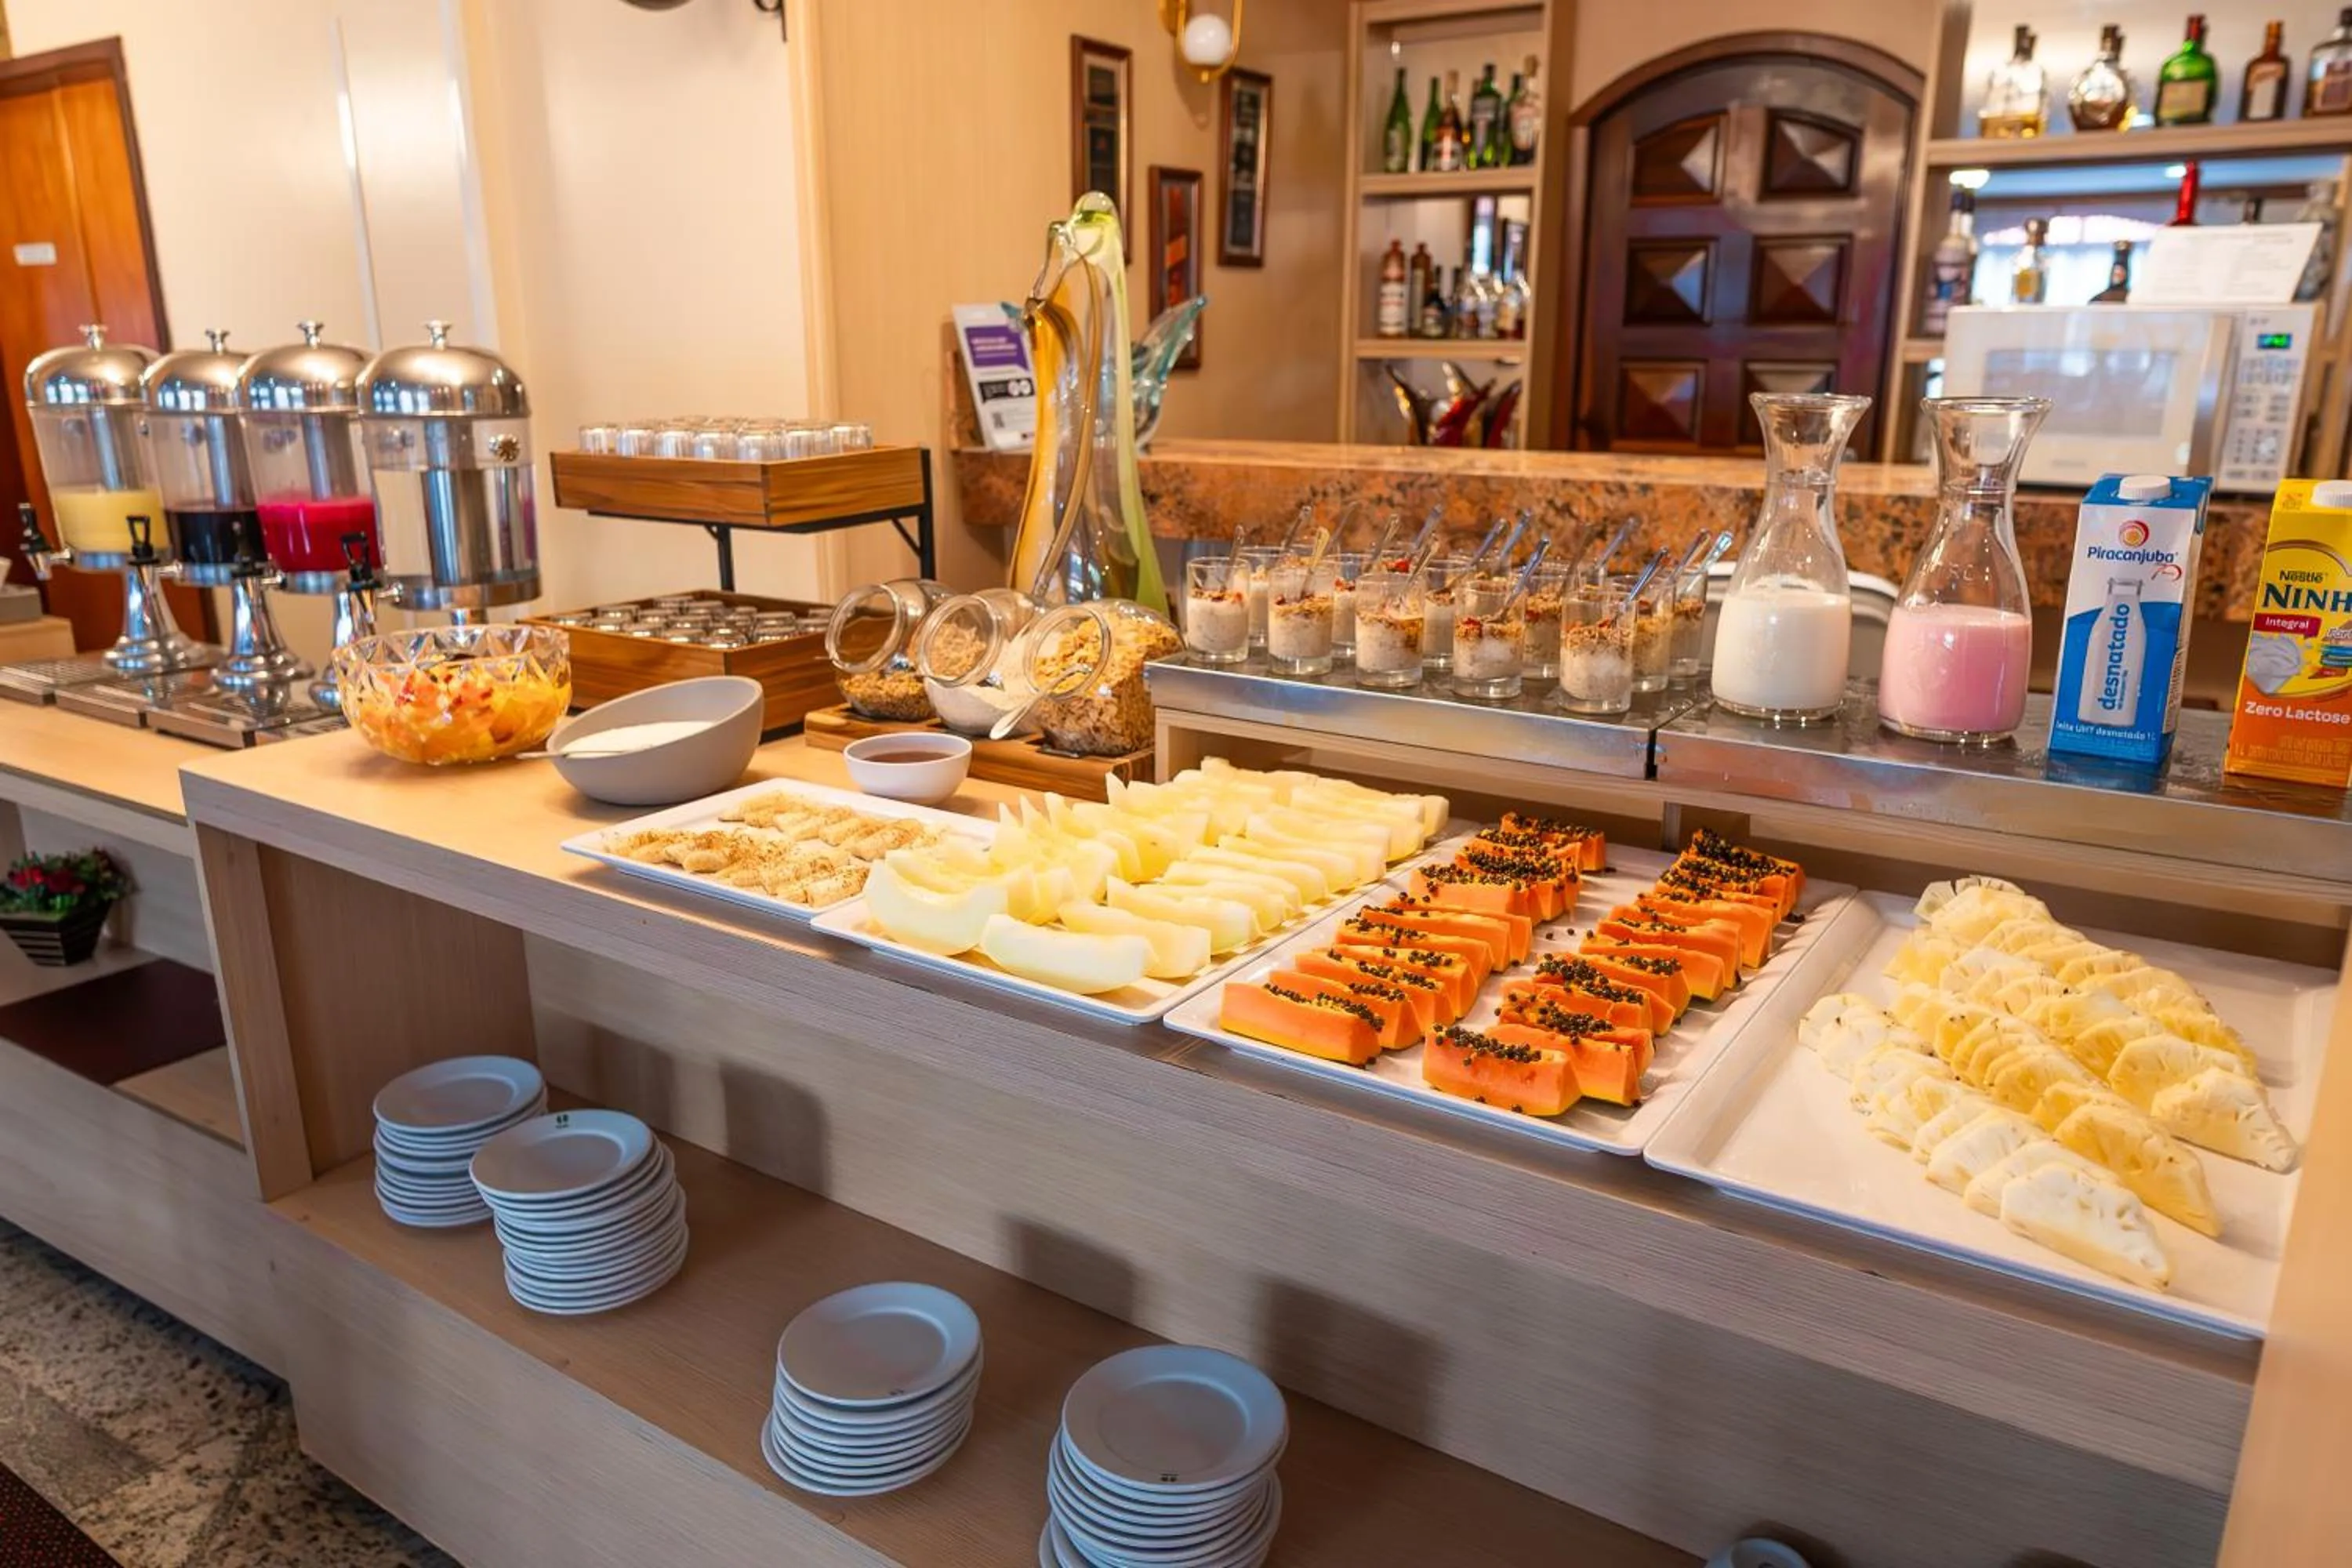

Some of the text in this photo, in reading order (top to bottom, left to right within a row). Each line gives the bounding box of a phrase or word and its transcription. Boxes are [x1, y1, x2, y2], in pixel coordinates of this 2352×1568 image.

[2087, 546, 2175, 564] Piracanjuba
[2265, 616, 2310, 630] Integral
[2097, 603, 2130, 710] desnatado
[2245, 700, 2351, 724] Zero Lactose
